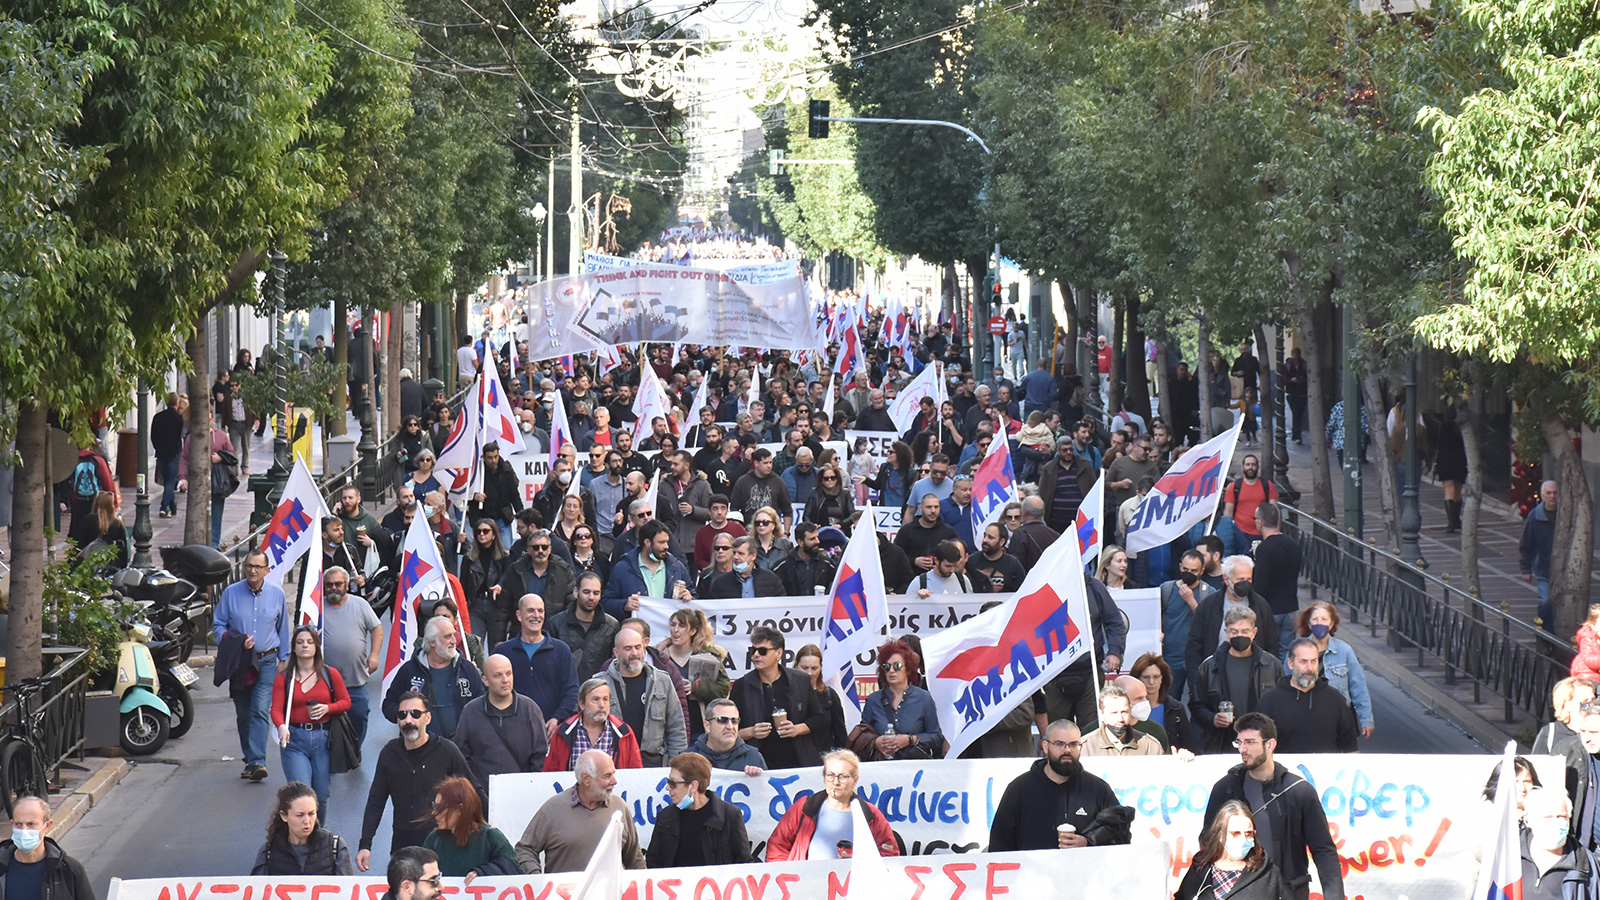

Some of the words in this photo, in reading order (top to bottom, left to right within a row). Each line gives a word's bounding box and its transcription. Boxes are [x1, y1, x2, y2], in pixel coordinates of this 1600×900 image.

[594, 271, 628, 284] THINK
[629, 269, 648, 279] AND
[649, 269, 679, 279] FIGHT
[680, 270, 704, 280] OUT
[524, 460, 551, 476] ΚΑΝ
[458, 678, 473, 698] R
